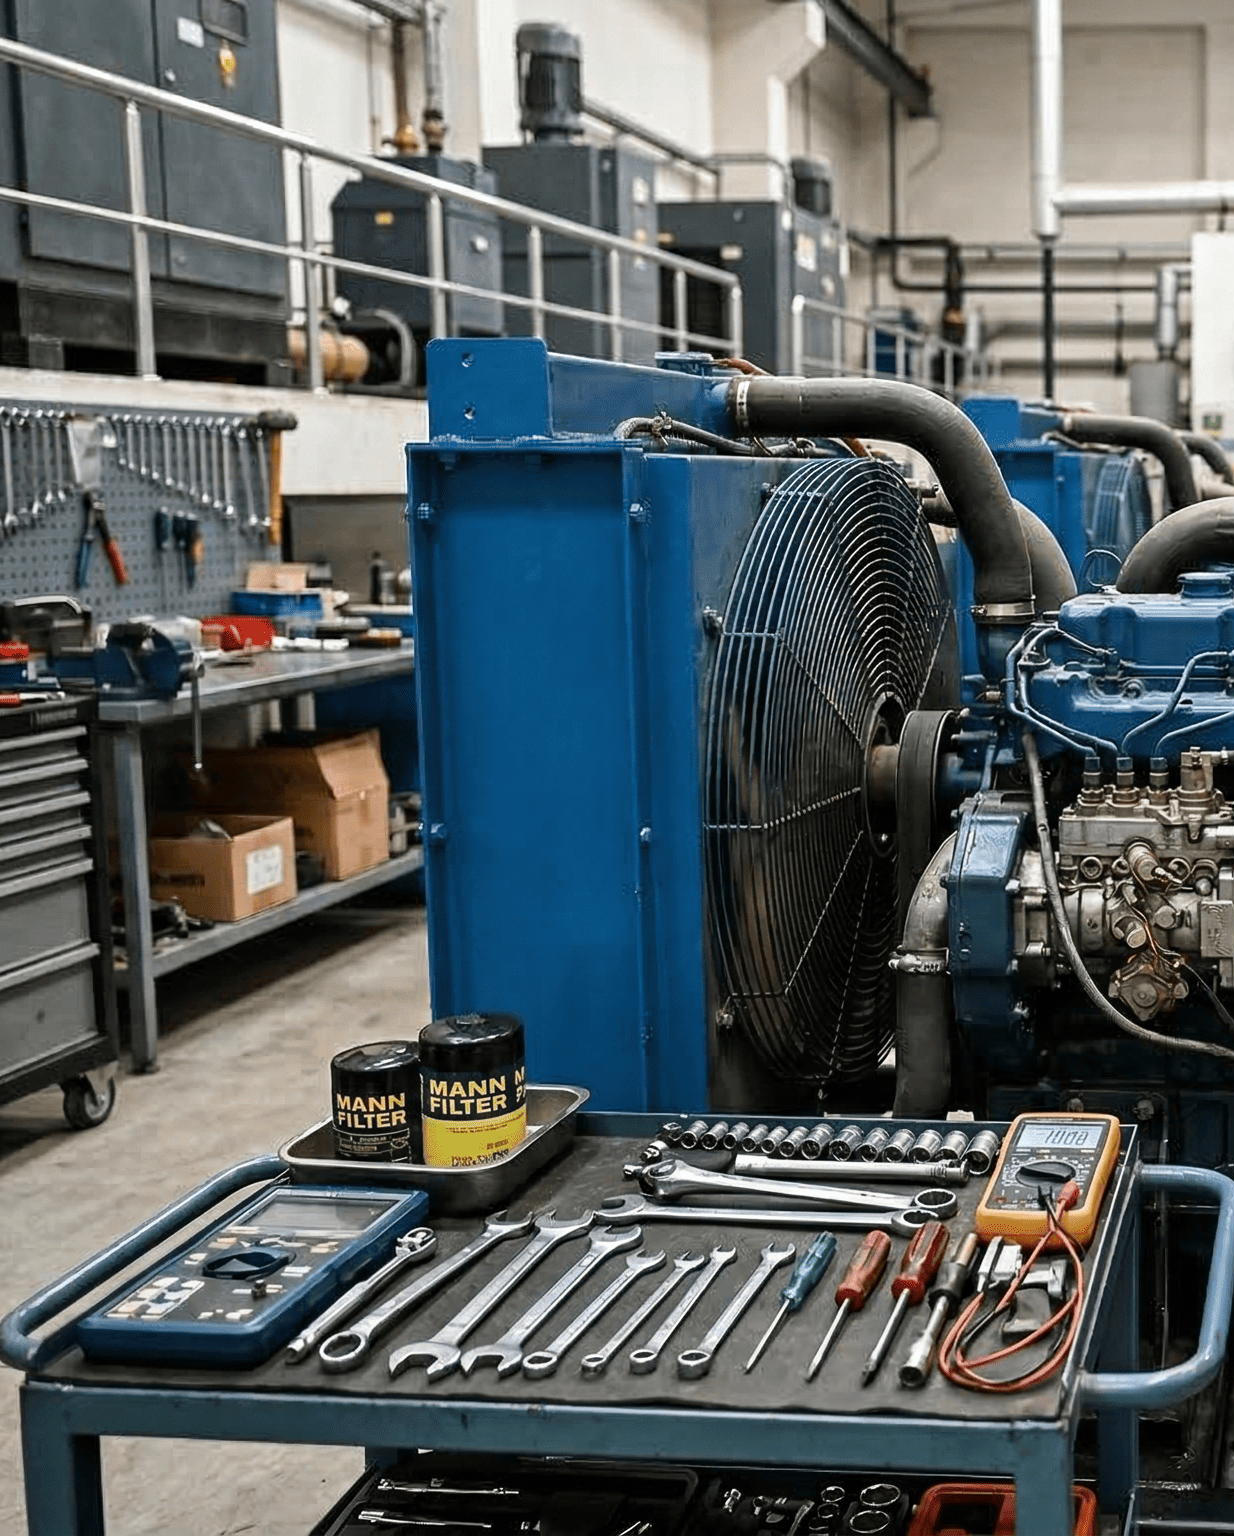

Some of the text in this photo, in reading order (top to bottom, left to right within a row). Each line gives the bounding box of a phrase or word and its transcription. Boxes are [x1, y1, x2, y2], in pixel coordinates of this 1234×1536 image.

[429, 1075, 506, 1098] MANN
[336, 1092, 406, 1112] MANN
[429, 1093, 508, 1115] FILTER
[337, 1110, 407, 1129] FILTER
